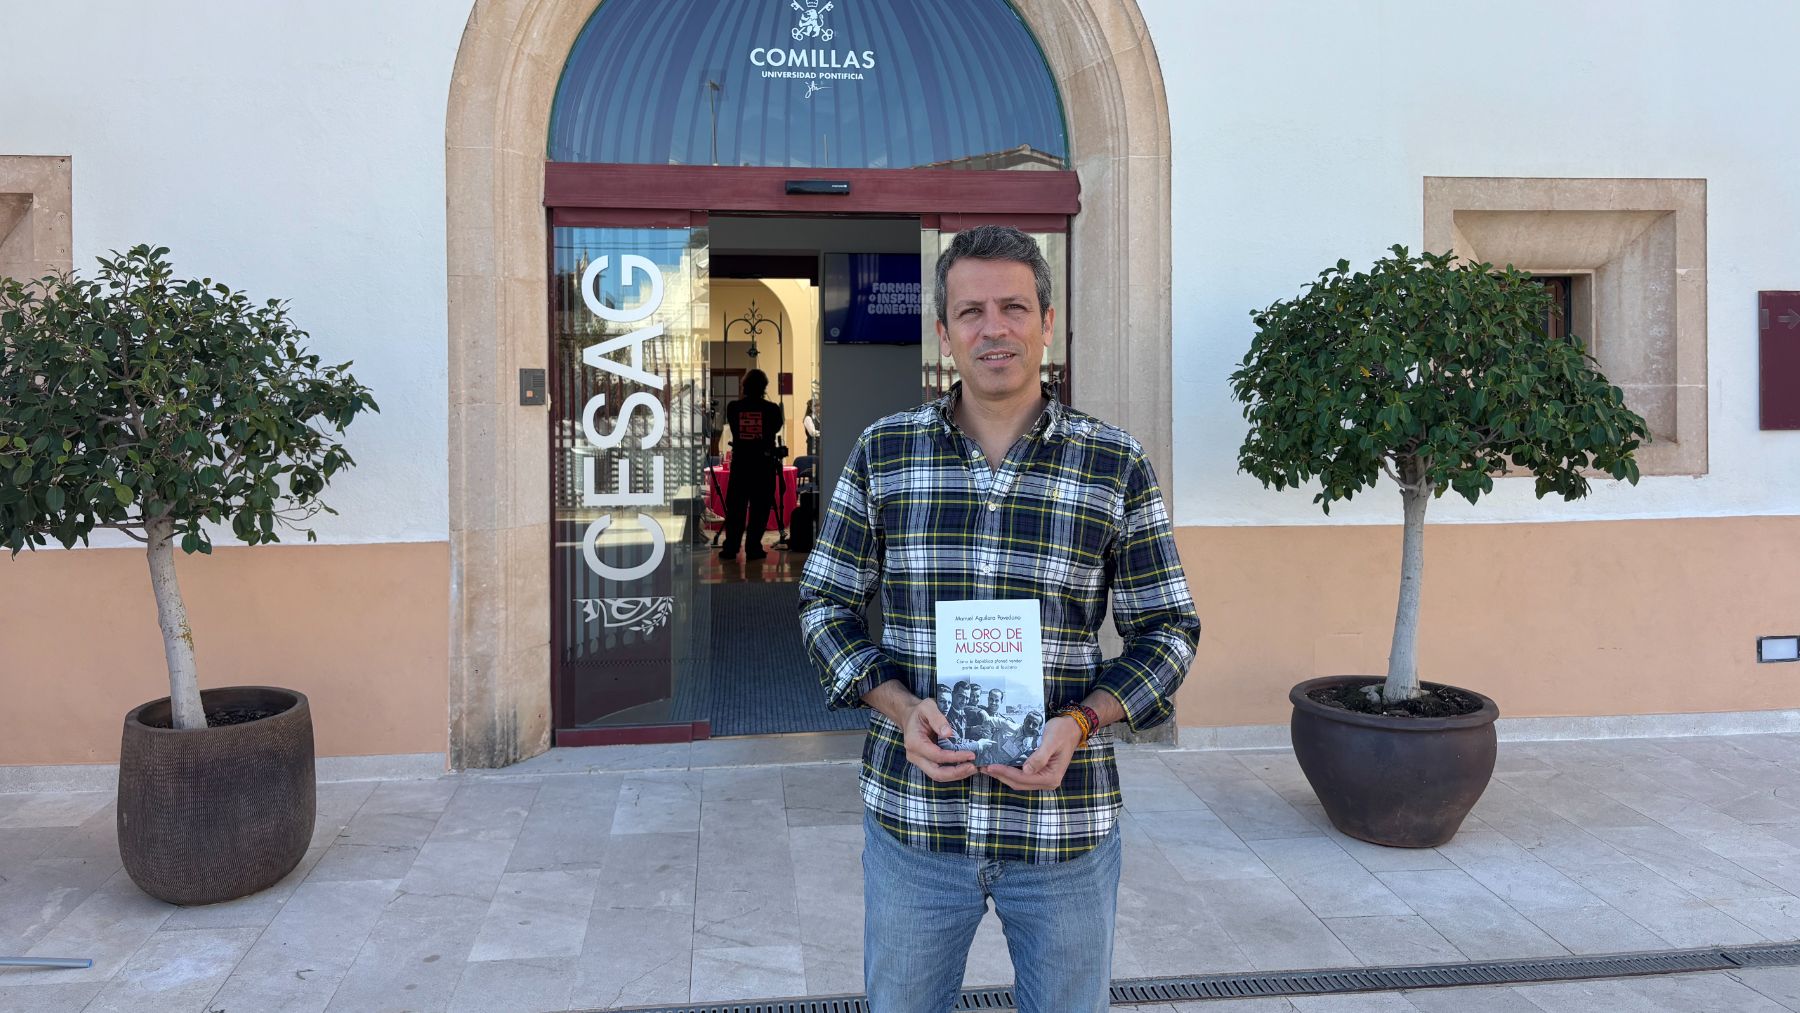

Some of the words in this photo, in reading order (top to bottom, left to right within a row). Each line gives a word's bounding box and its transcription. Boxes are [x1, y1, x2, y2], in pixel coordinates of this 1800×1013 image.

[750, 48, 875, 69] COMILLAS
[761, 71, 817, 79] UNIVERSIDAD
[819, 72, 864, 80] PONTIFICIA
[872, 282, 921, 293] FORMAR
[581, 254, 666, 581] CESAG
[955, 628, 967, 640] EL
[972, 628, 1001, 640] ORO
[1006, 628, 1022, 640] DE
[955, 641, 1023, 653] MUSSOLINI
